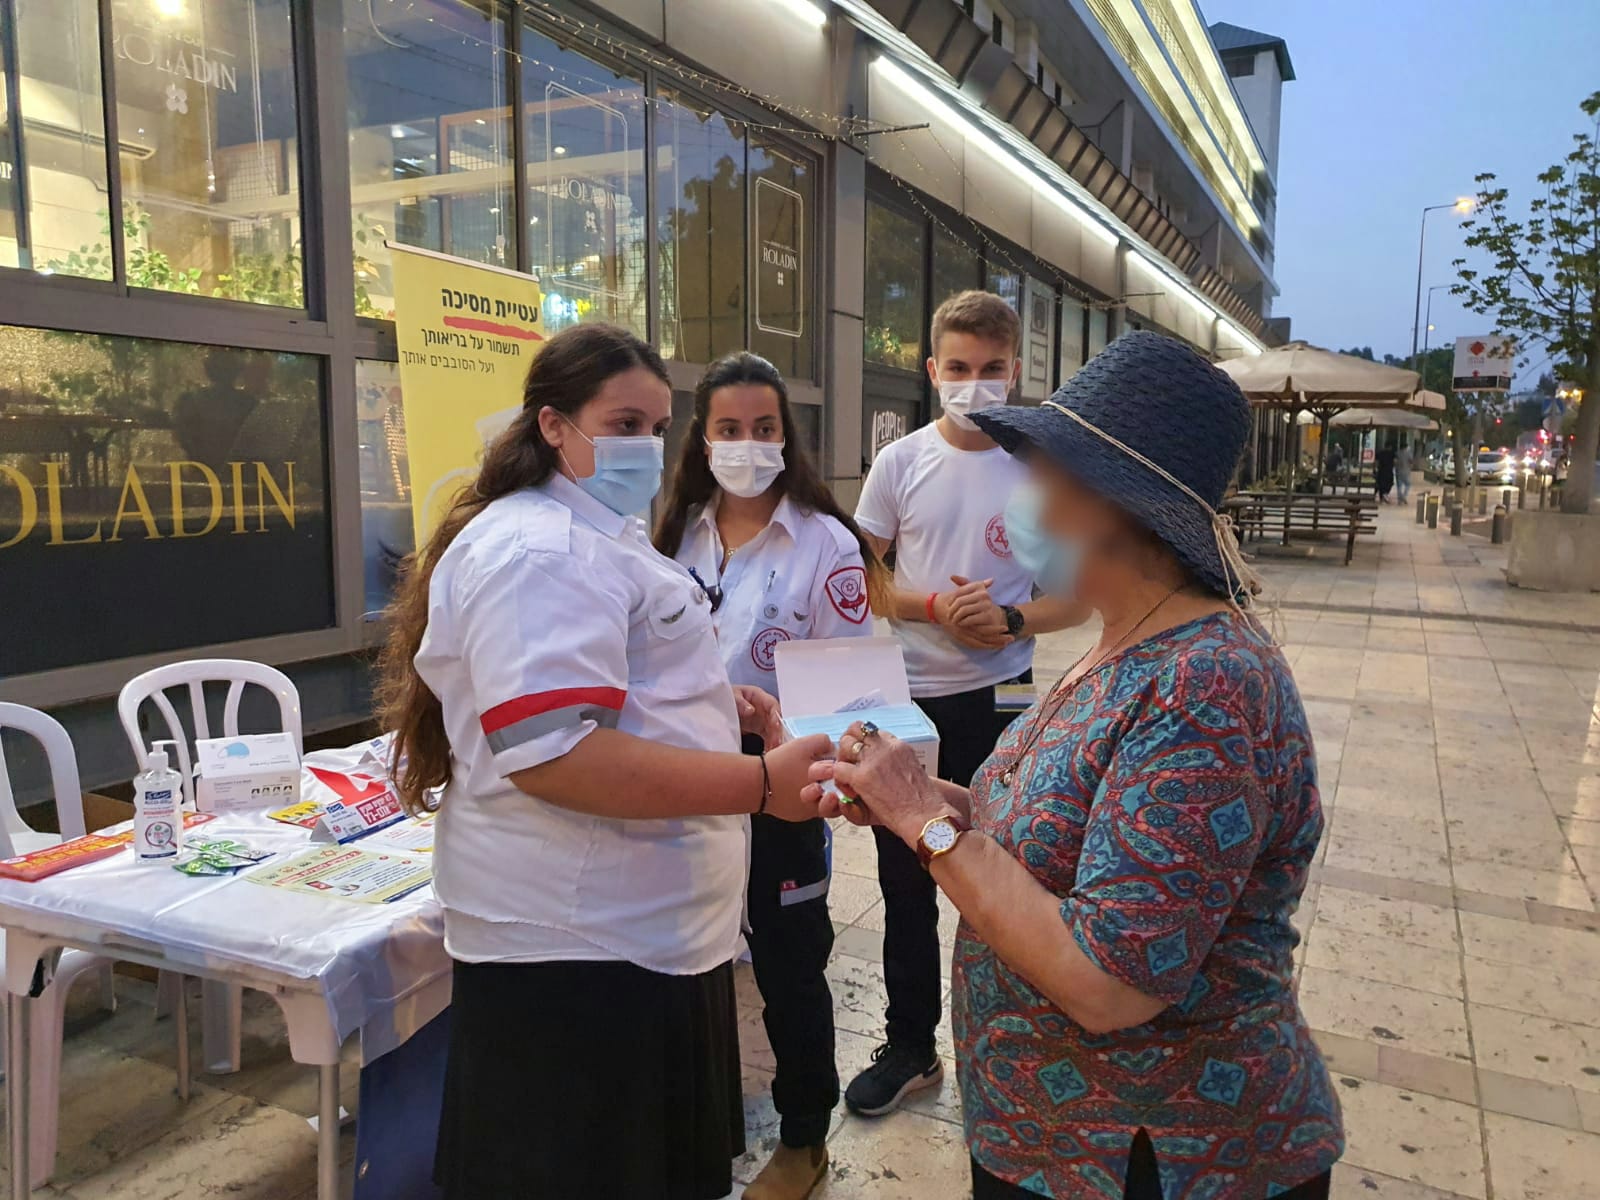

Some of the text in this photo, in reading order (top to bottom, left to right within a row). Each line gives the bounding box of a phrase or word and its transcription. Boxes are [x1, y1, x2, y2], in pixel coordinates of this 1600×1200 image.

[763, 247, 798, 270] ROLADIN
[441, 288, 539, 323] עטיית מסיכה
[421, 328, 520, 356] תשמור על בריאותך
[401, 350, 495, 374] ועל הסובבים אותך
